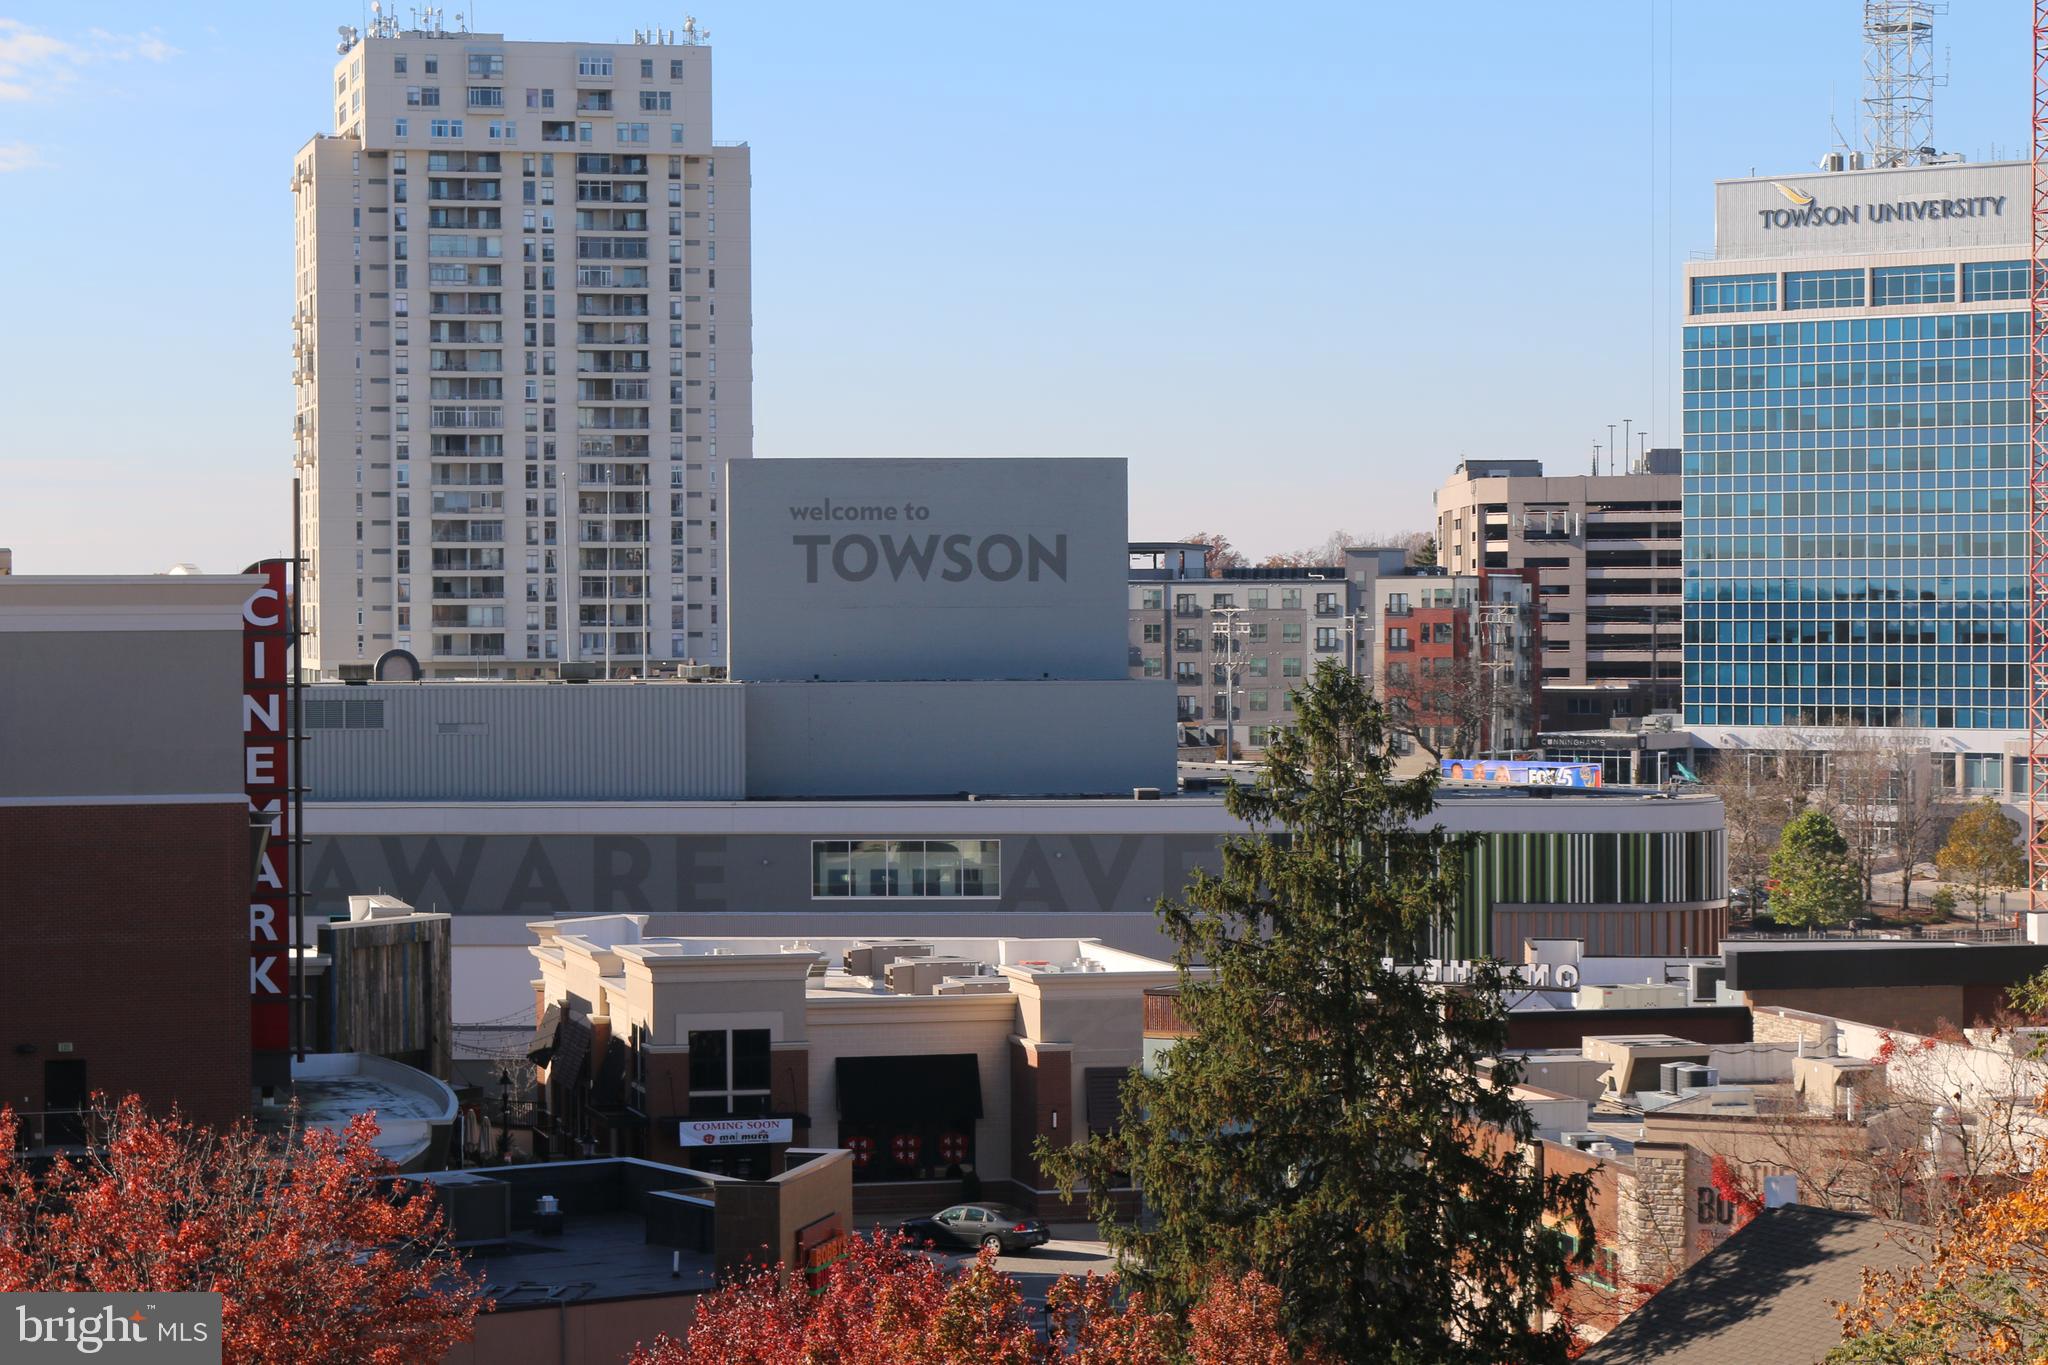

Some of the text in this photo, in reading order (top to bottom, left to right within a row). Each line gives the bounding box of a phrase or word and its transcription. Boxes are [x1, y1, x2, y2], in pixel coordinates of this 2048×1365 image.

[1759, 195, 2006, 230] TOWSON UNIVERSITY
[790, 497, 930, 521] welcome to
[792, 533, 1068, 583] TOWSON
[1808, 734, 1930, 746] TOWSON CITY CENTER
[243, 588, 282, 995] CINEMARK
[693, 1120, 780, 1131] COMING SOON
